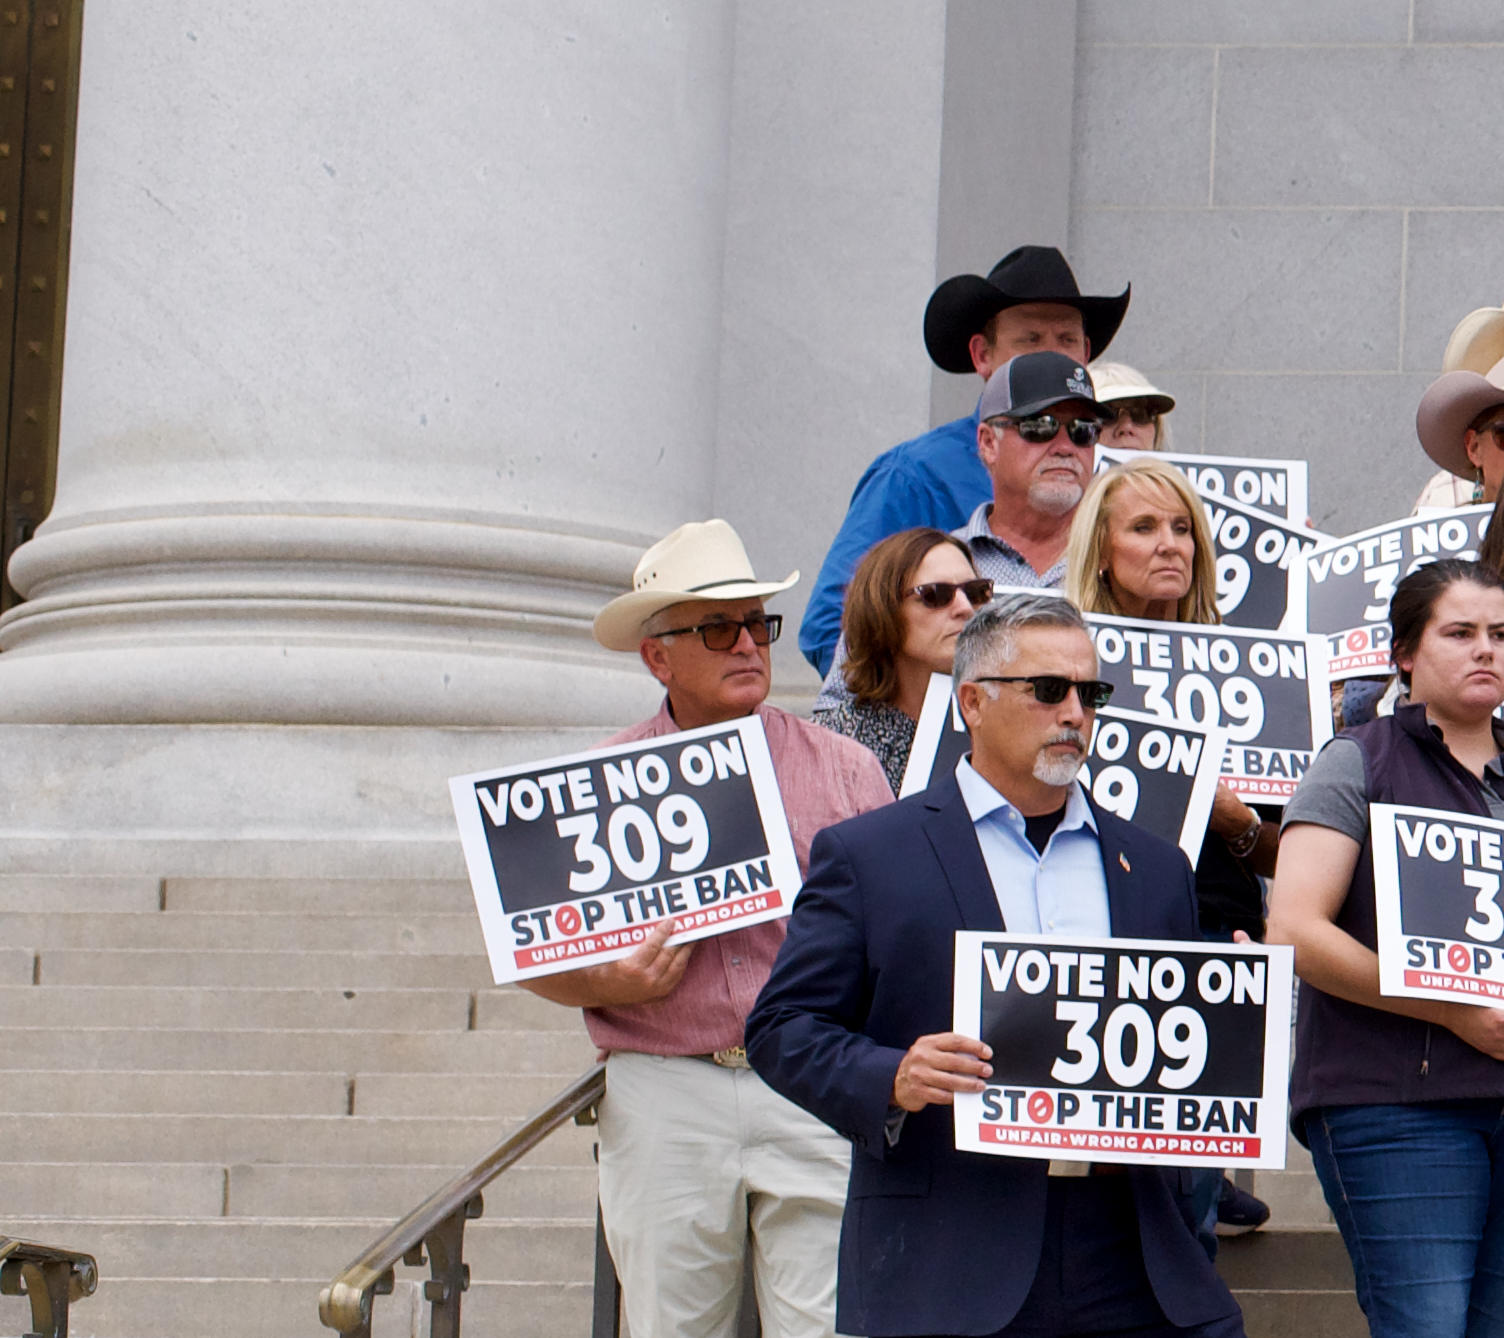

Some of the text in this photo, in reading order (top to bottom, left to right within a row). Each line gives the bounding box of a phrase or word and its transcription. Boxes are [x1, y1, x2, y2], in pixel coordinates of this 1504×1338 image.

[1309, 535, 1402, 580] VOTE
[475, 736, 746, 827] VOTE NO ON
[556, 793, 709, 892] 309
[1398, 812, 1501, 871] VOTE
[613, 880, 688, 922] THE
[693, 861, 773, 905] BAN
[672, 897, 767, 931] APPROACH
[984, 949, 1265, 1004] VOTE NO ON
[1051, 1001, 1207, 1089] 309
[1092, 1094, 1164, 1130] THE
[1177, 1098, 1257, 1135] BAN
[1141, 1137, 1243, 1154] APPROACH
